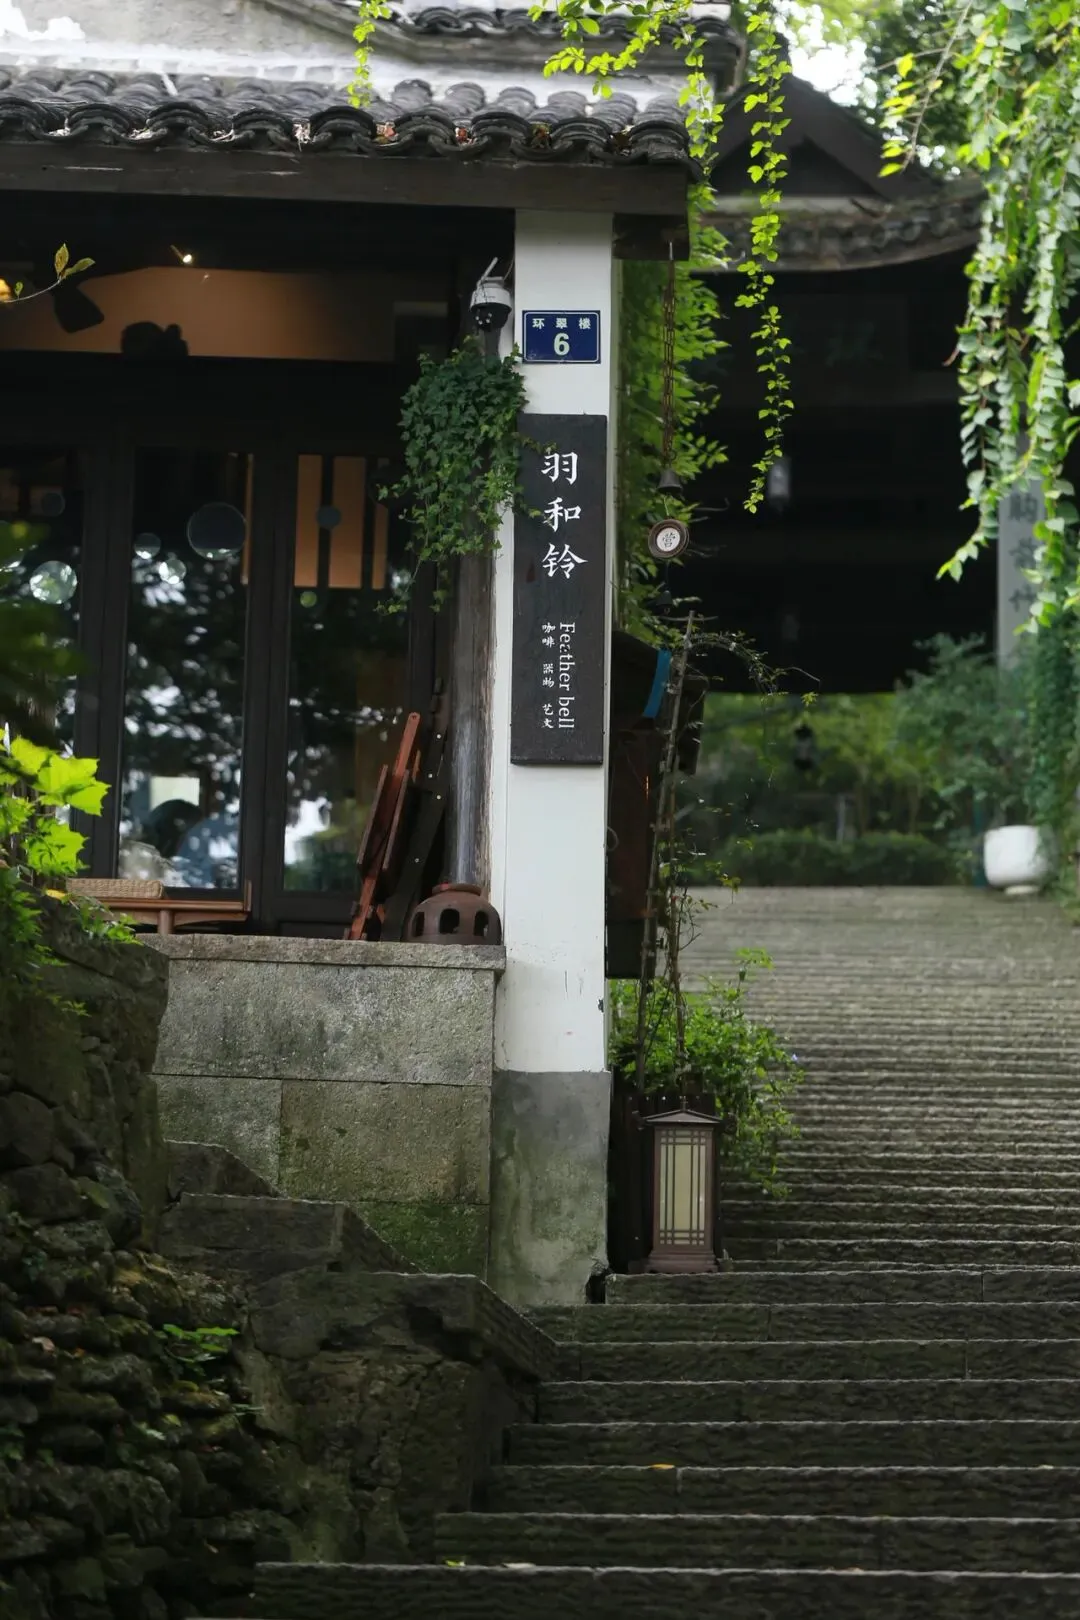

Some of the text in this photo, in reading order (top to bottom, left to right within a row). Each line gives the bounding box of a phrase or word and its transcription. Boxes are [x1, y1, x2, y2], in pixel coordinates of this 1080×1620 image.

[532, 317, 591, 329] 环翠楼
[553, 332, 570, 356] 6
[541, 451, 588, 579] 羽和铃
[542, 621, 556, 649] 咖啡
[558, 622, 576, 729] Feather bell
[542, 703, 554, 729] 艺文
